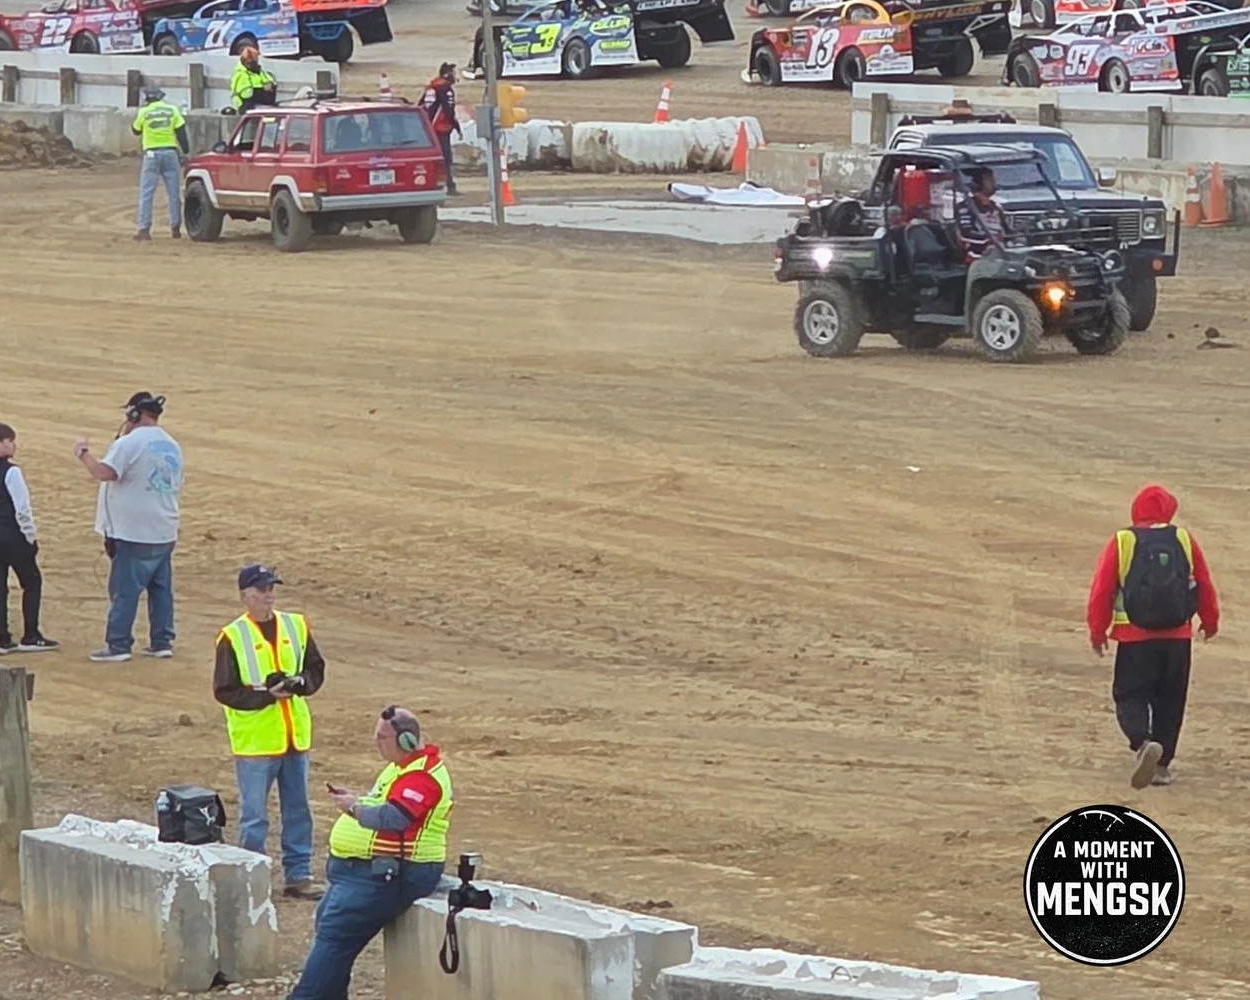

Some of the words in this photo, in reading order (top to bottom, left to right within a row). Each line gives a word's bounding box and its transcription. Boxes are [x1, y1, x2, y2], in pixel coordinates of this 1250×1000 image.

[40, 18, 72, 45] 22
[806, 28, 839, 68] 13
[1065, 45, 1100, 76] 93
